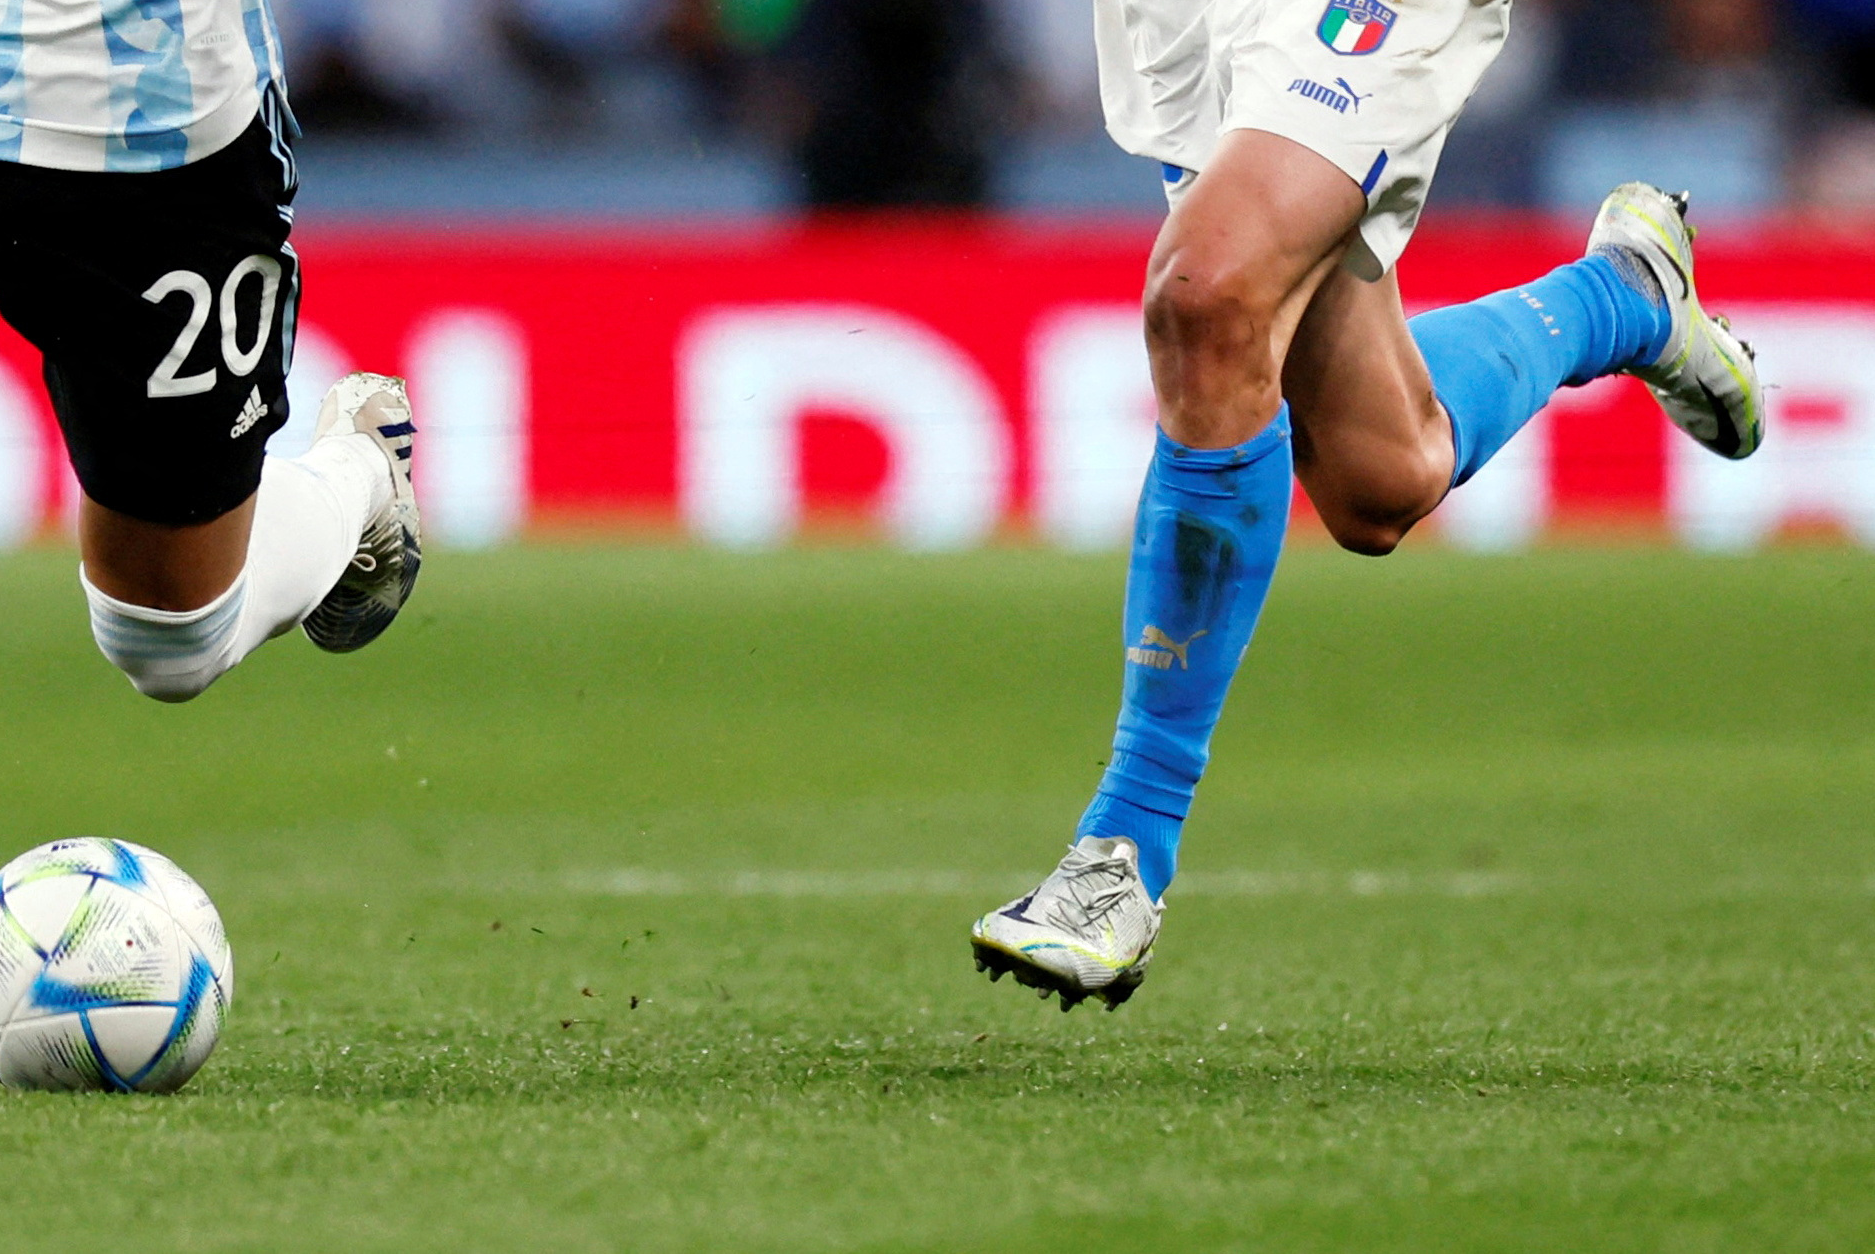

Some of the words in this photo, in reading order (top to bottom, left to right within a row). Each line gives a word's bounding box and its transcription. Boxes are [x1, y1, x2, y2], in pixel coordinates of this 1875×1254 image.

[1286, 79, 1351, 115] PUMA
[141, 254, 282, 398] 20
[230, 404, 268, 439] adidas
